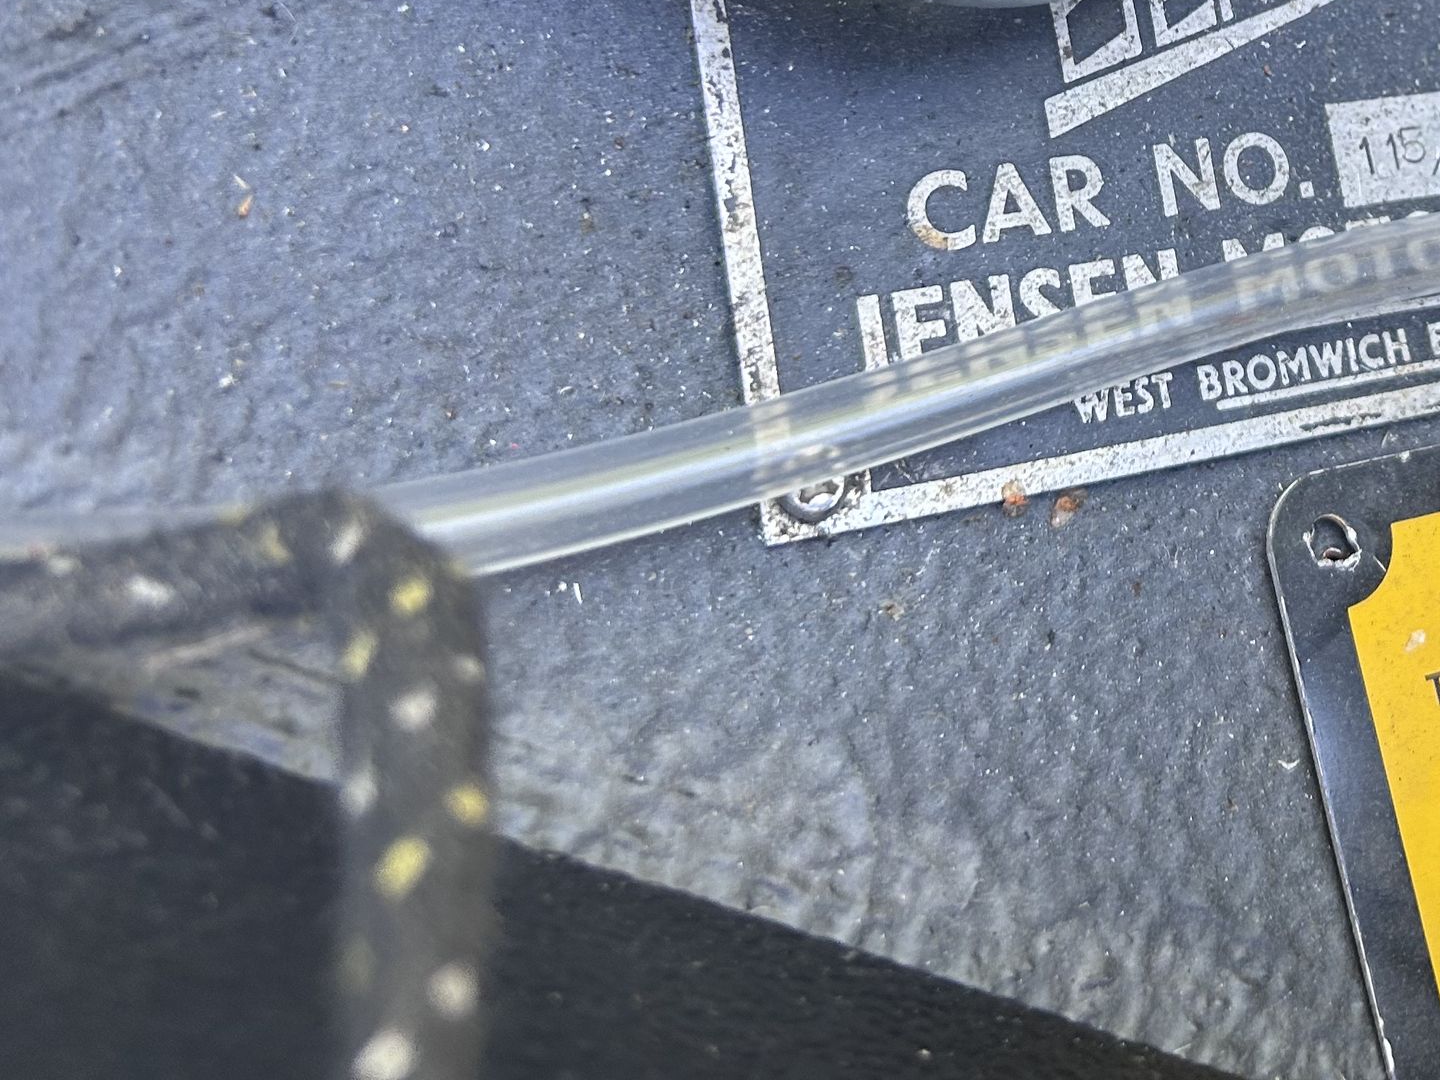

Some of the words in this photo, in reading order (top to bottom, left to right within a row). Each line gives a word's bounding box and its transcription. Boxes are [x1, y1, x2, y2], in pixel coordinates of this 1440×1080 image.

[907, 154, 1110, 251] CAR
[1153, 132, 1314, 217] NO.
[1072, 372, 1173, 424] WEST
[1196, 328, 1411, 401] BROMWICH
